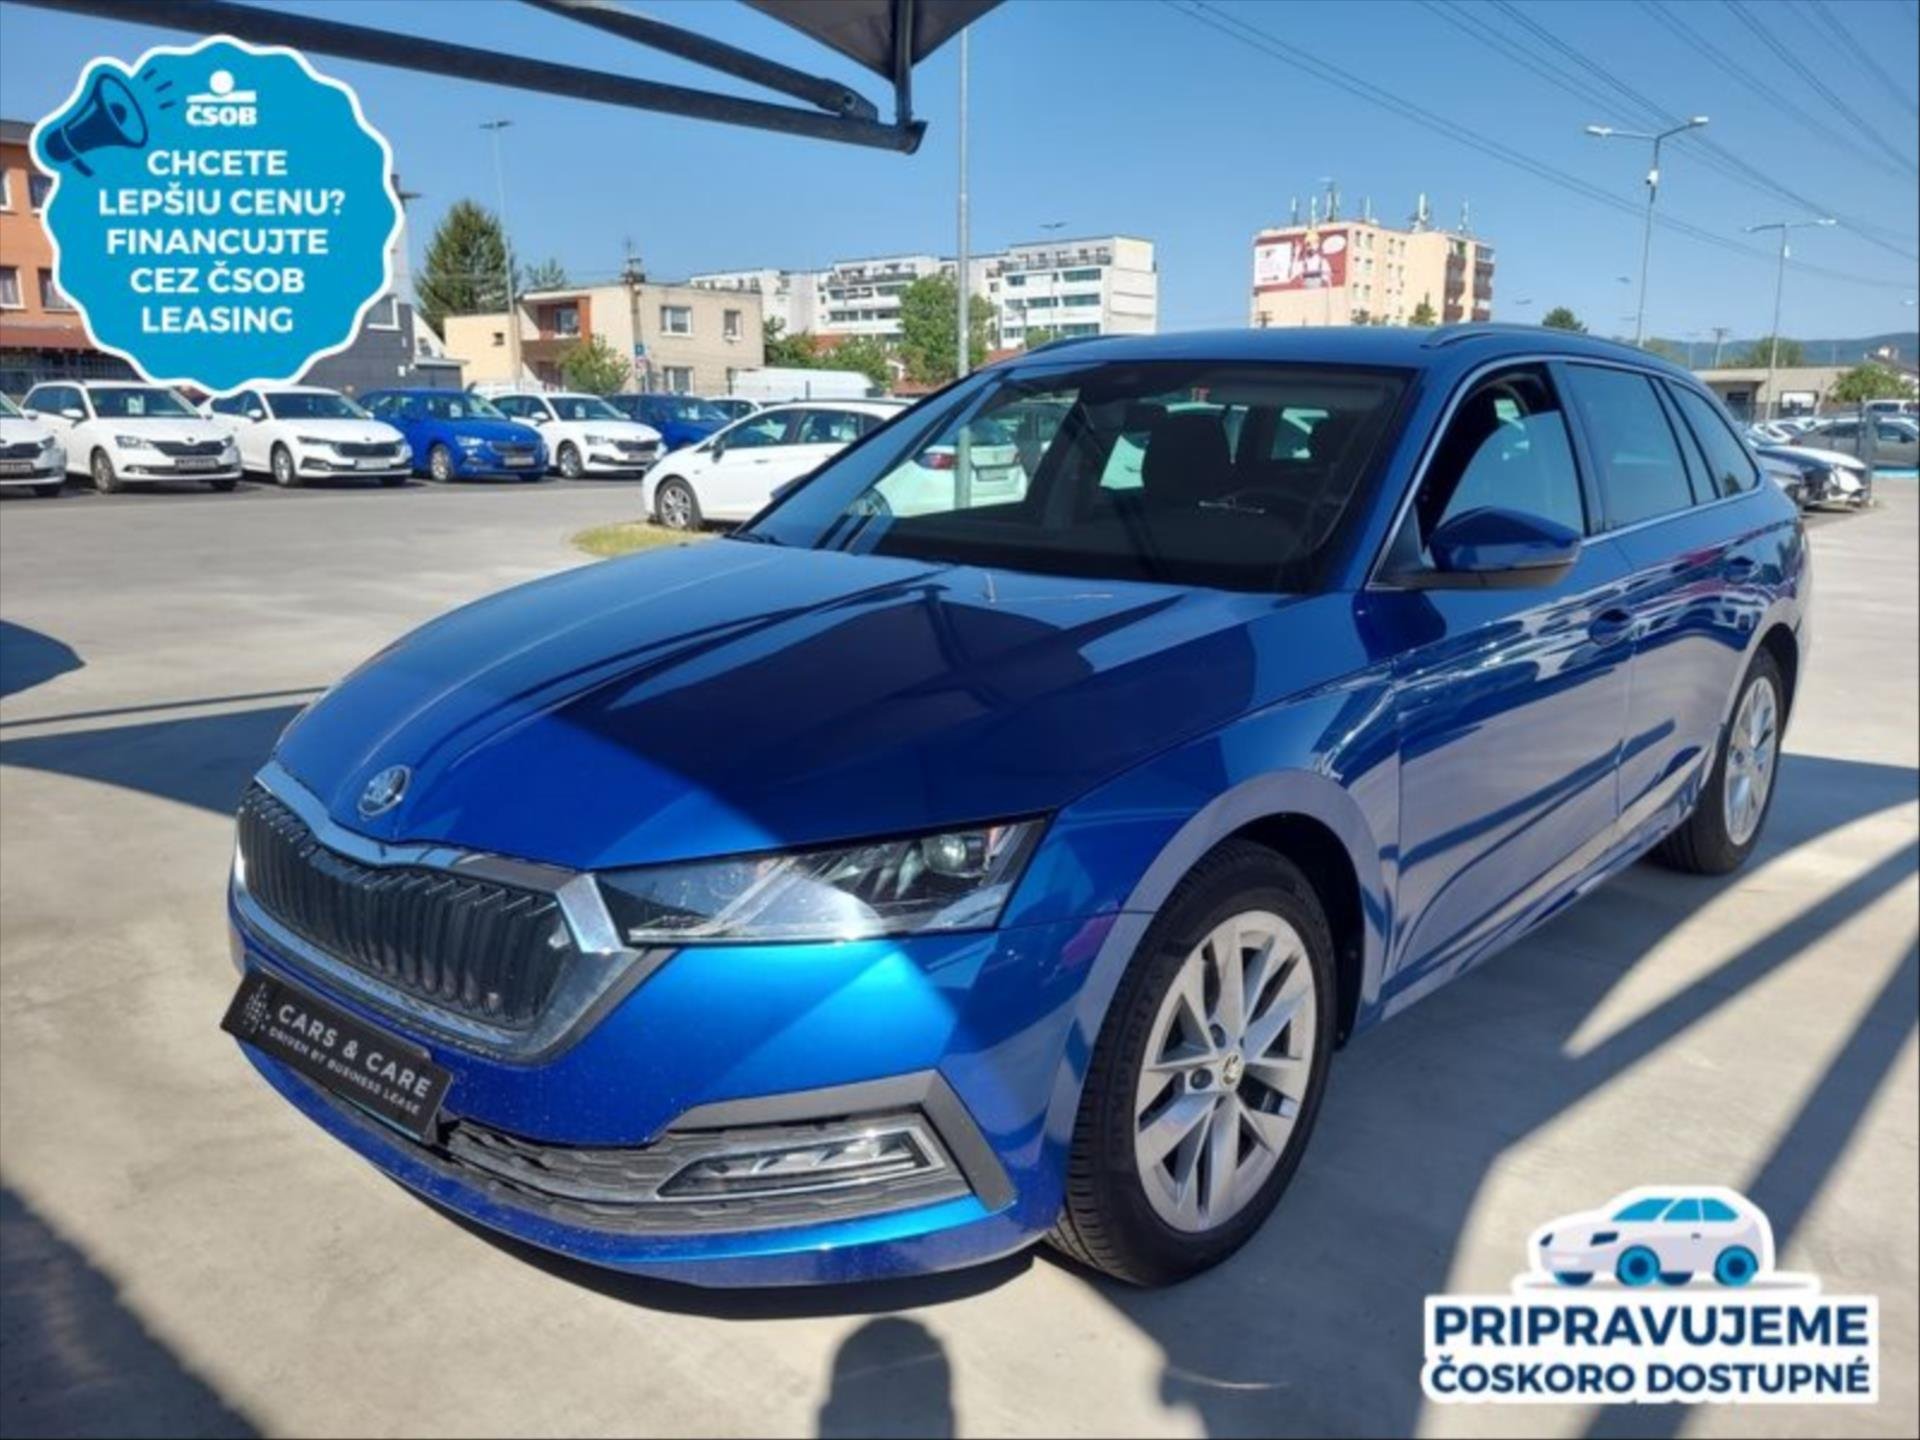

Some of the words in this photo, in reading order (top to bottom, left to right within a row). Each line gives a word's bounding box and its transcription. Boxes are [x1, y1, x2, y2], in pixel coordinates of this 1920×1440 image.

[269, 1026, 308, 1055] DRIVEN
[310, 1050, 326, 1063] BY
[327, 1058, 381, 1094] BUSINESS
[383, 1089, 421, 1116] LEASE
[278, 1003, 338, 1048] CARS
[342, 1040, 358, 1059] &
[365, 1052, 431, 1098] CARE
